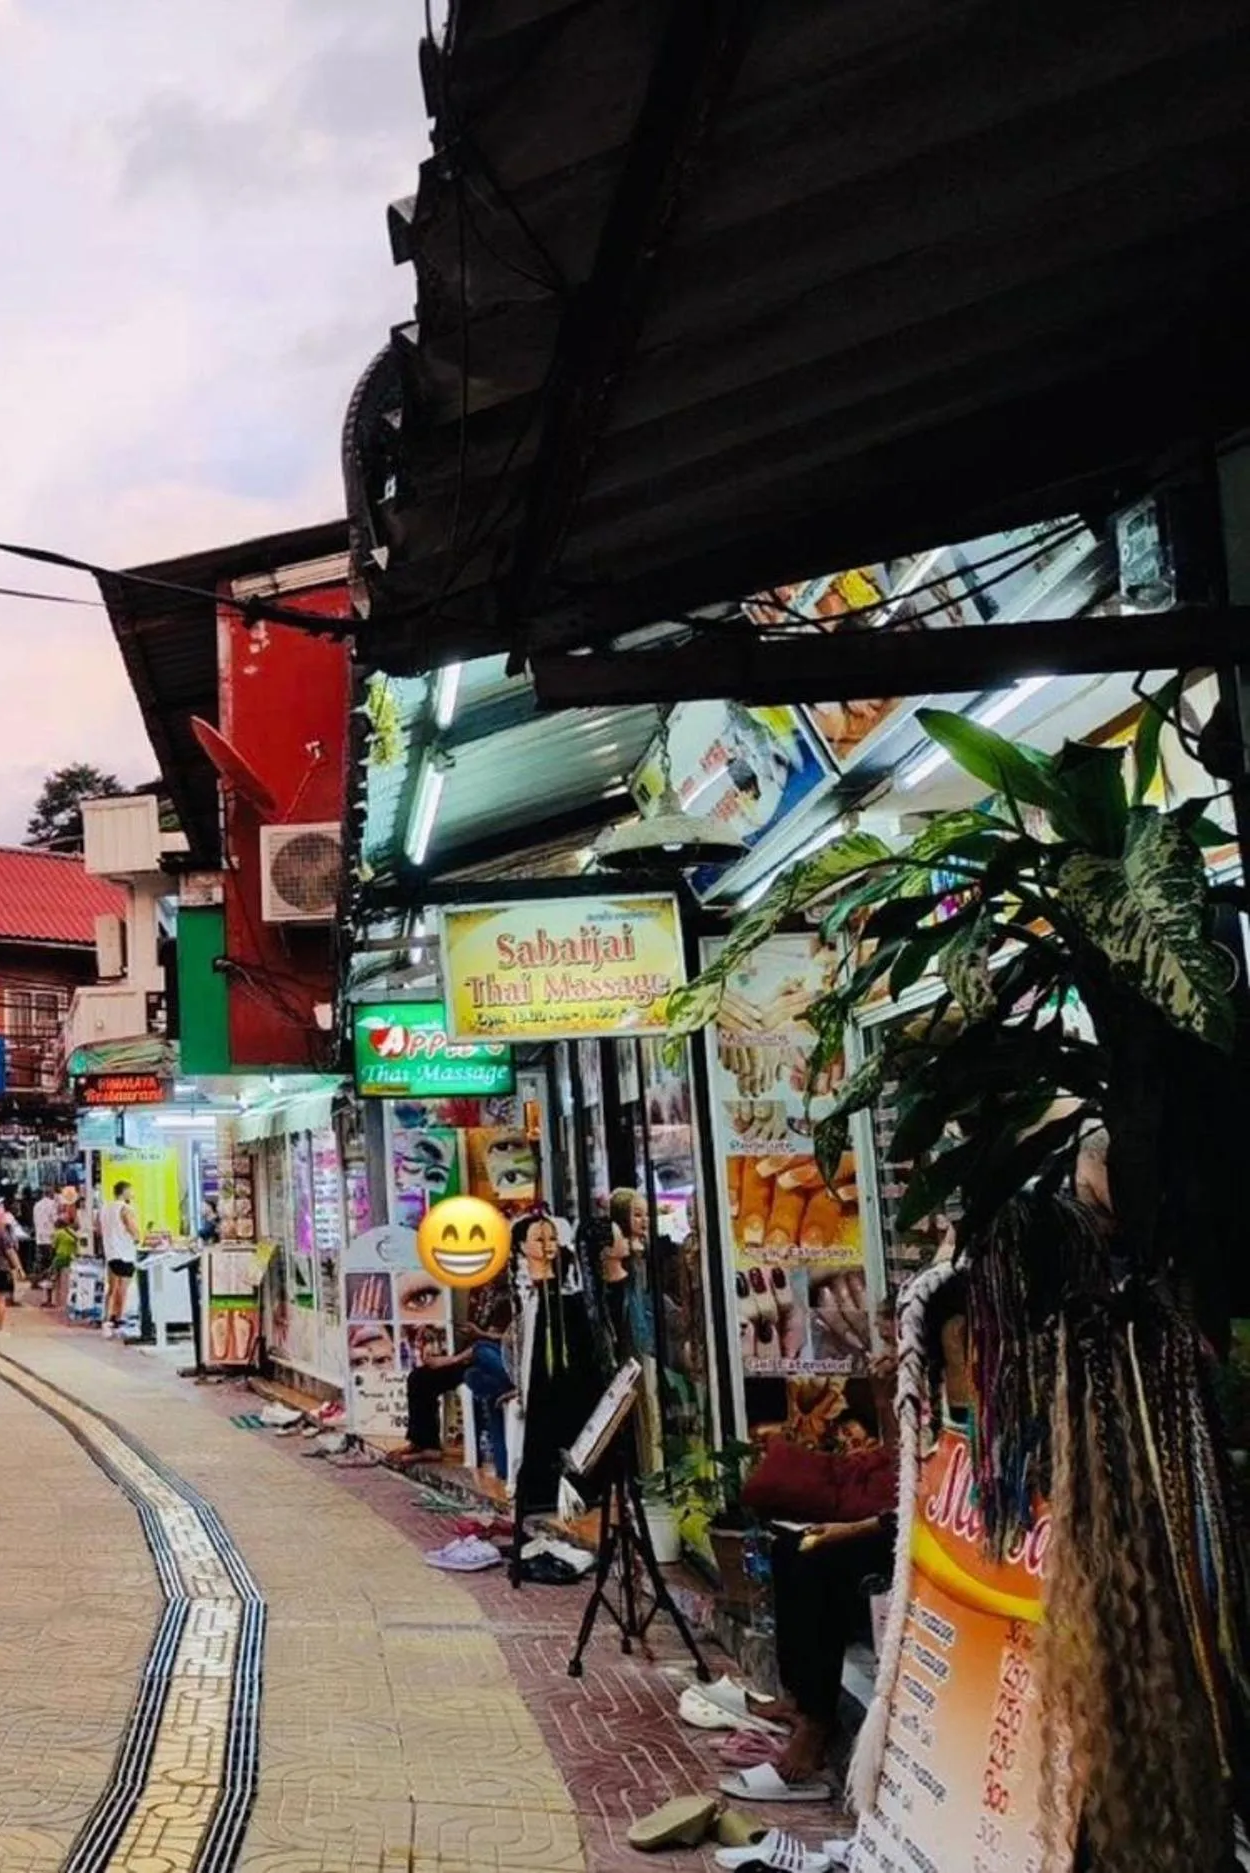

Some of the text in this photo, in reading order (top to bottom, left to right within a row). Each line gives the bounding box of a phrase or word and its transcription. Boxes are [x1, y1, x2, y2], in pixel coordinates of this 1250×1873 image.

[496, 921, 637, 974] Sabaijai
[464, 970, 672, 1009] Thai Massage
[362, 1063, 509, 1086] Thai Massage
